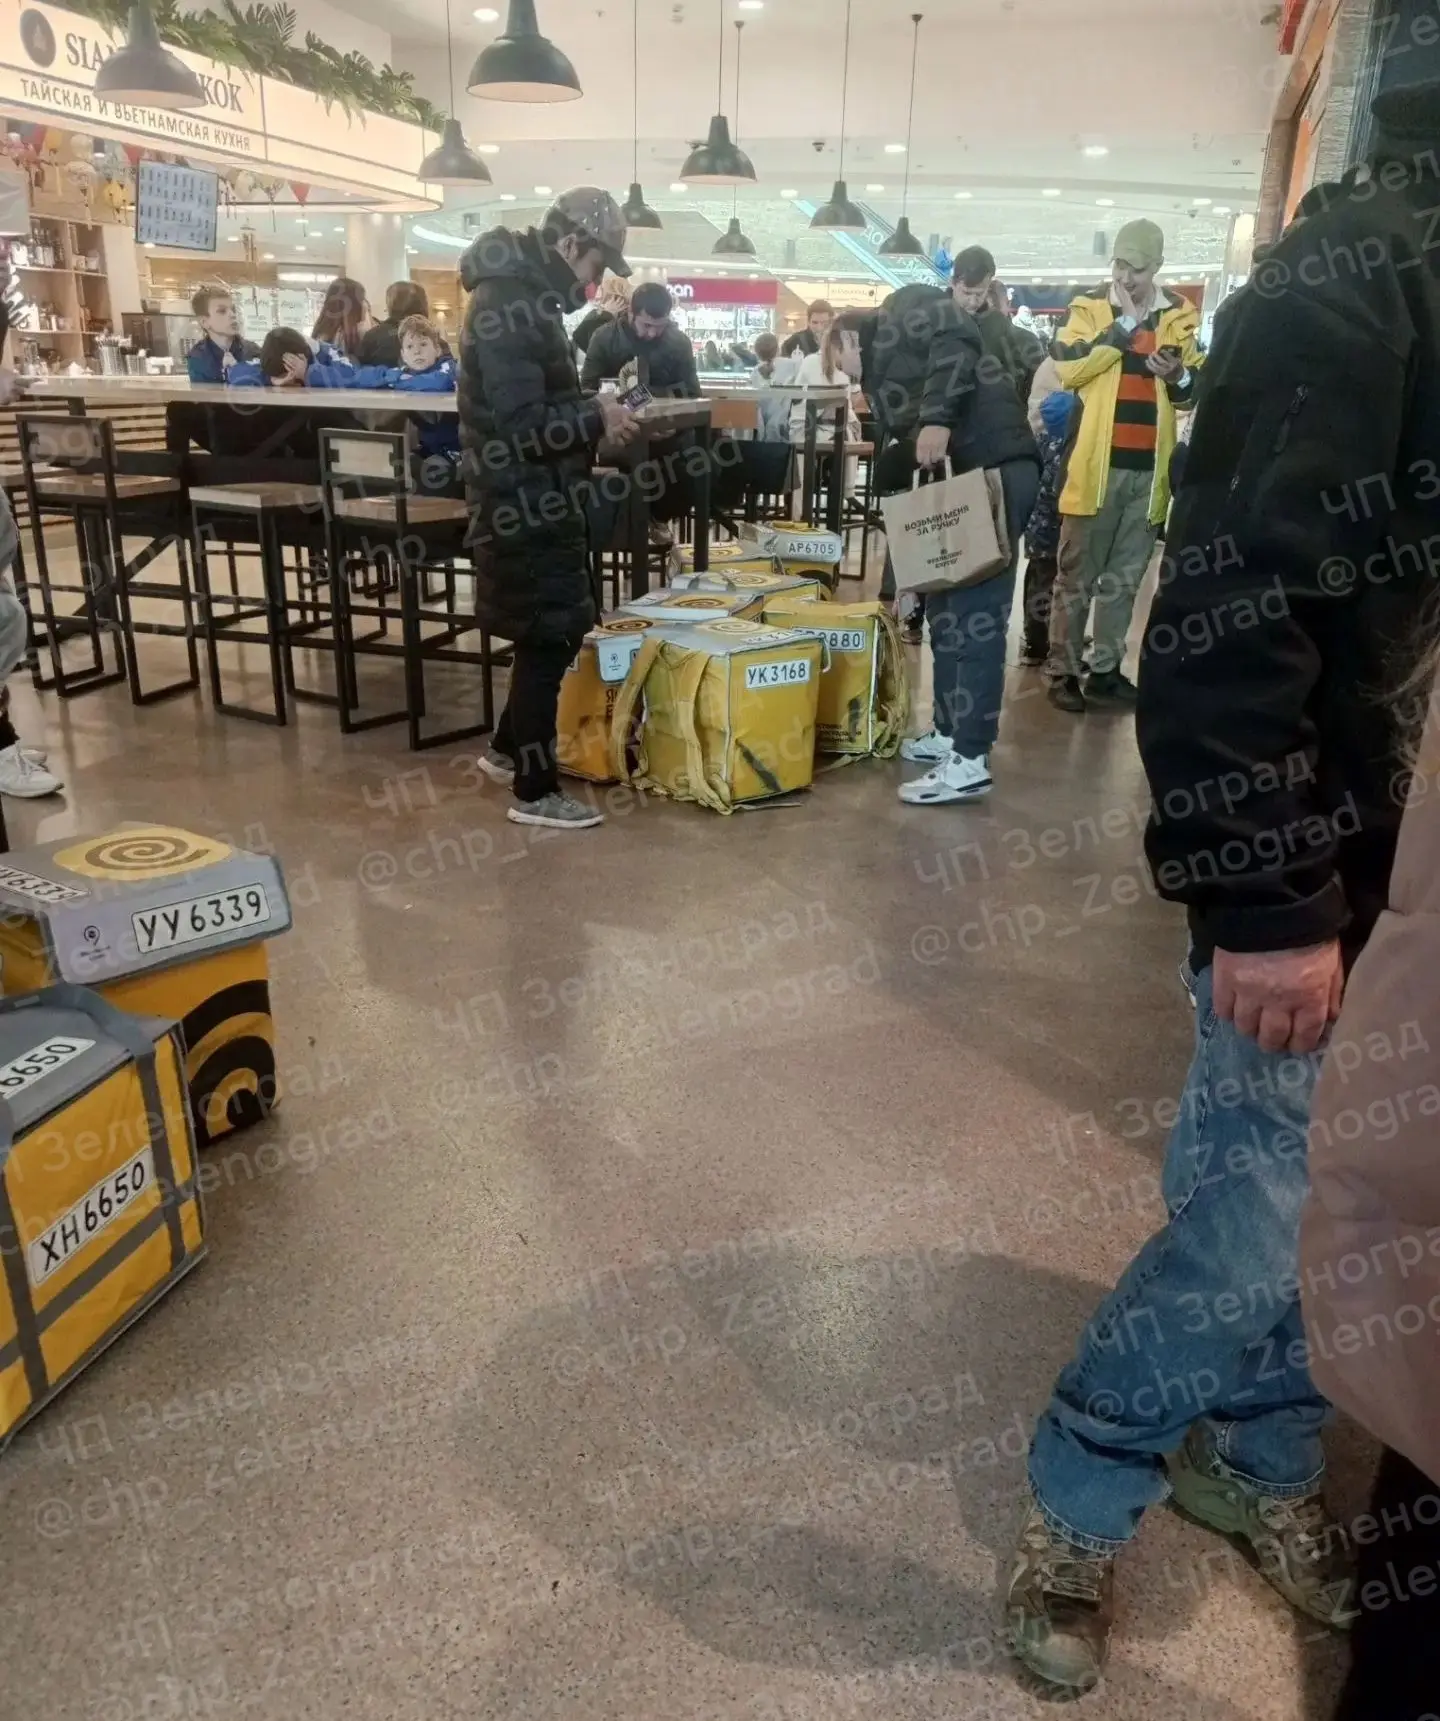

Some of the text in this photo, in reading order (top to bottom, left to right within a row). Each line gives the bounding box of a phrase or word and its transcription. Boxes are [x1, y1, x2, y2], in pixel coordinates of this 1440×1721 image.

[20, 78, 251, 151] ТАЙСКАЯ И ВЬЕТНАМСКАЯ КУХНЯ
[904, 504, 970, 532] ВОЗЬМИ МЕНЯ
[931, 517, 960, 531] РУЧКУ
[40, 1160, 146, 1272] ХН6650
